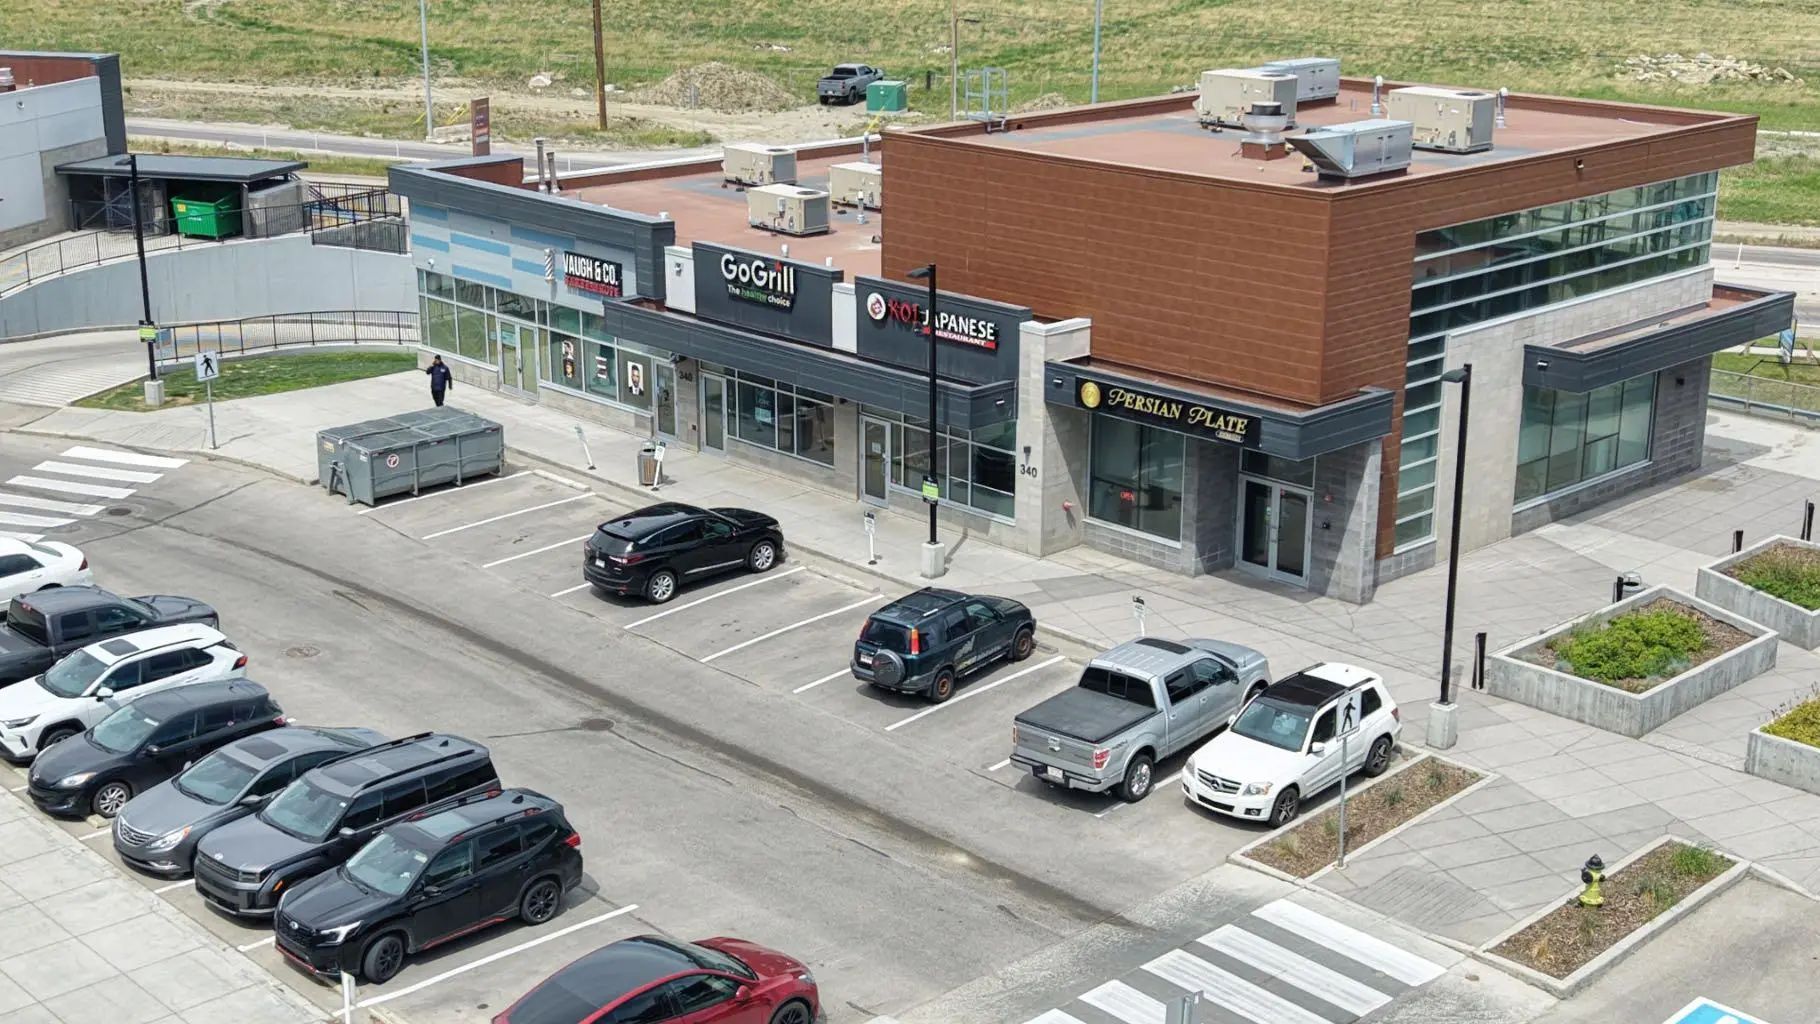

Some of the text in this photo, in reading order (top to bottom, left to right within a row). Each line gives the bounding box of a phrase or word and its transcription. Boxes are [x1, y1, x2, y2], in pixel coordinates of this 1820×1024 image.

[562, 252, 593, 280] VAUGH
[594, 261, 601, 281] &
[603, 263, 618, 286] CO.
[721, 253, 794, 294] GoGrill
[728, 284, 740, 295] The
[767, 294, 790, 308] choice
[888, 298, 919, 323] KOI
[680, 370, 693, 382] 340
[1108, 388, 1248, 435] PERSIAN PLATE
[1020, 464, 1037, 478] 340
